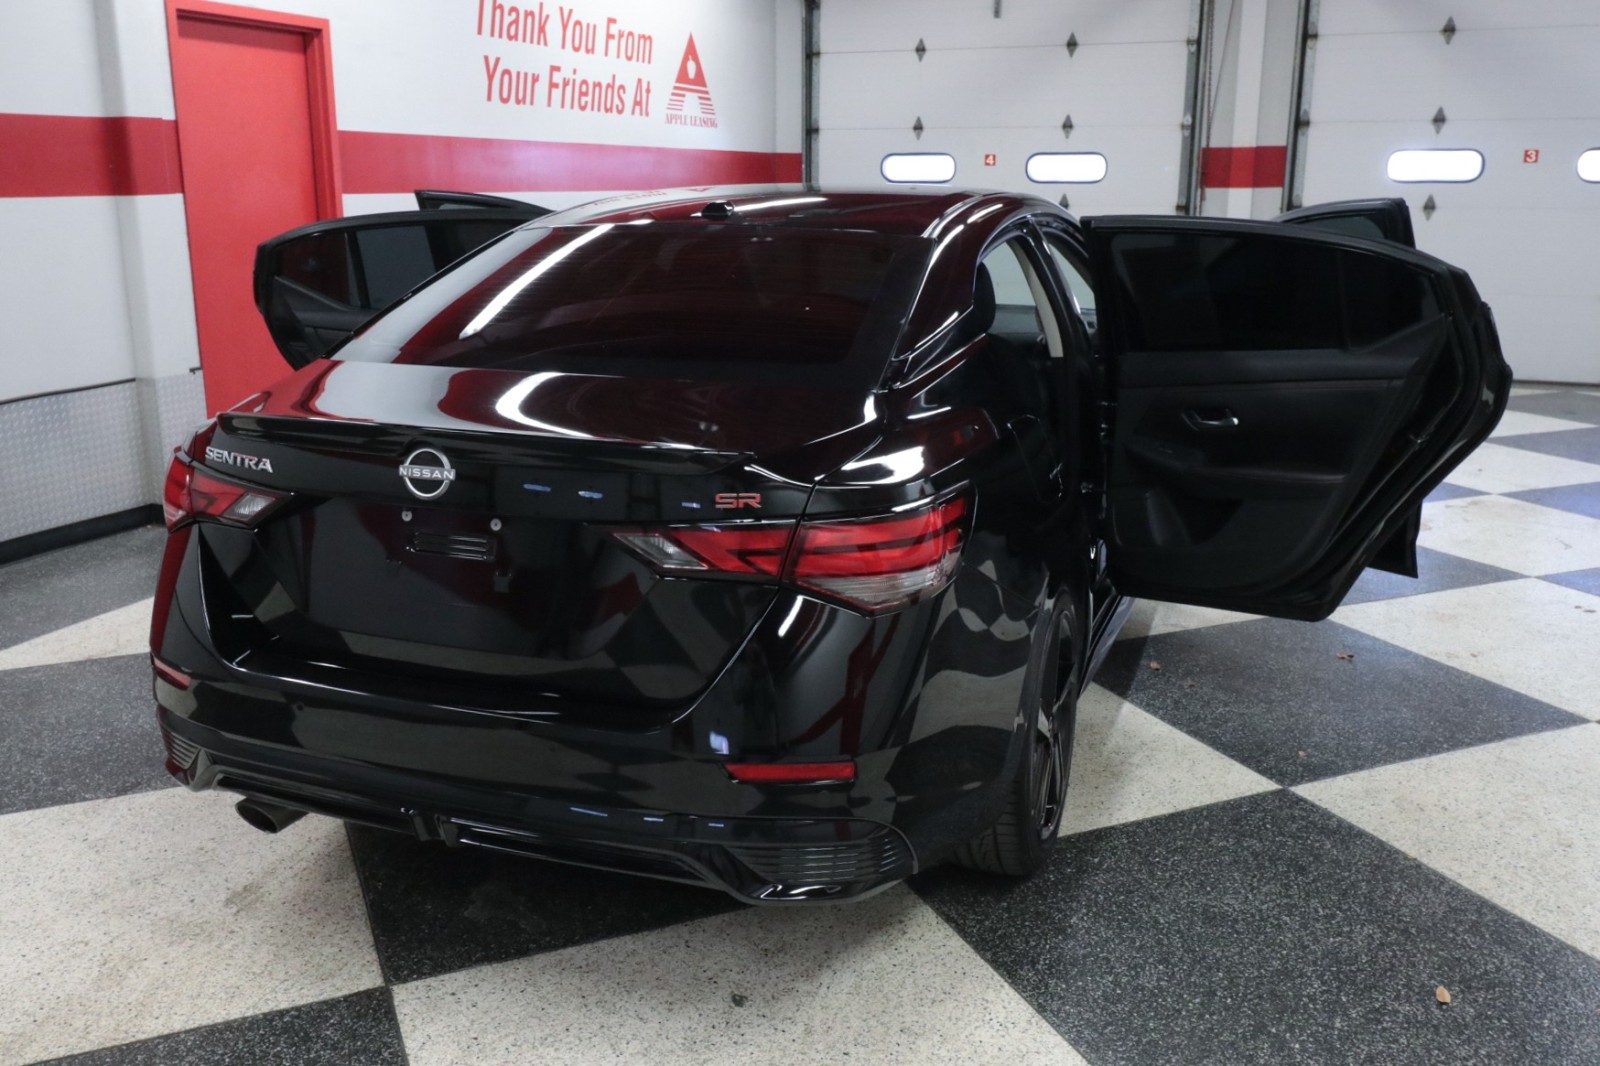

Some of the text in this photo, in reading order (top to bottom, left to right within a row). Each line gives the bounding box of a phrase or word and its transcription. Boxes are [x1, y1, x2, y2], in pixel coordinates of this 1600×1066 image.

[477, 0, 653, 64] Thank You From
[483, 55, 651, 117] Your Friends At
[664, 113, 718, 128] APPLE LEASING
[985, 154, 995, 166] 4
[1525, 150, 1537, 163] 3
[205, 446, 273, 473] SENTRA
[399, 466, 456, 480] NISSAN
[715, 493, 762, 508] SR
